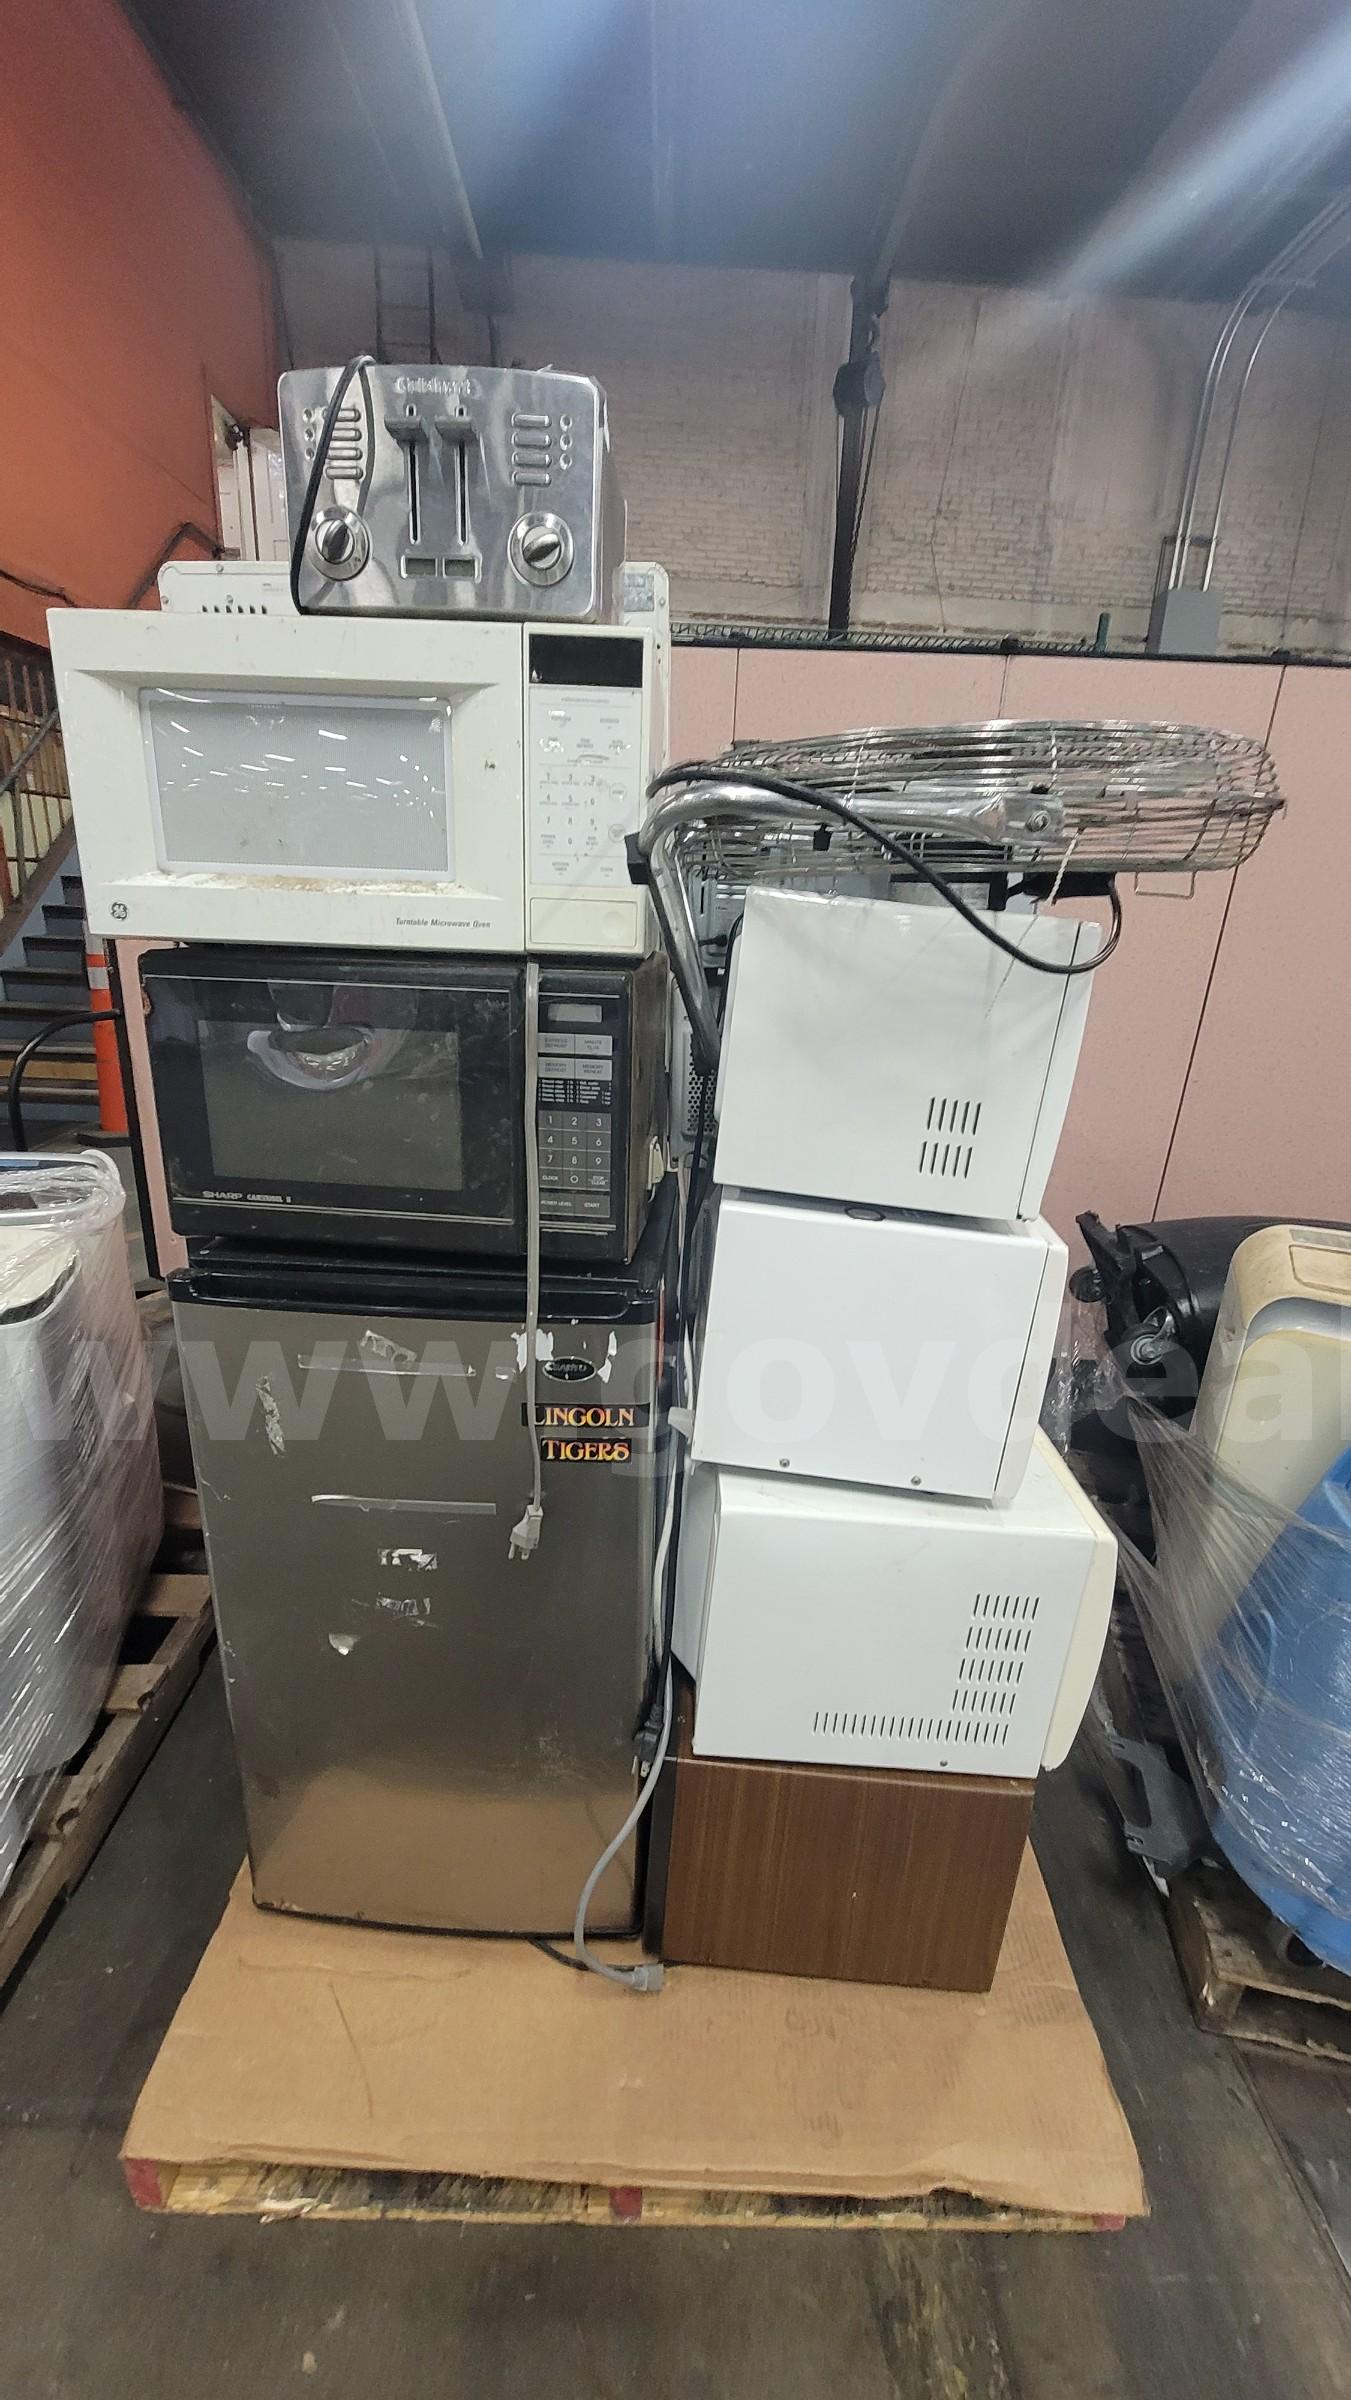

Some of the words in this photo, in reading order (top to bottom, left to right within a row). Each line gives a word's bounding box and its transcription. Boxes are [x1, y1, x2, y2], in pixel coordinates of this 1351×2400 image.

[396, 917, 429, 926] Turntable
[430, 918, 471, 928] Microwave
[472, 920, 491, 928] Oven
[547, 1115, 553, 1124] 1
[571, 1117, 578, 1126] 2
[595, 1118, 602, 1127] 3
[547, 1135, 553, 1144] 4
[571, 1136, 578, 1145] 5
[595, 1137, 602, 1146] 6
[547, 1154, 553, 1163] 7
[571, 1156, 578, 1165] 8
[595, 1157, 602, 1165] 9
[202, 1190, 243, 1200] SHARP
[541, 1439, 630, 1460] TIGERS
